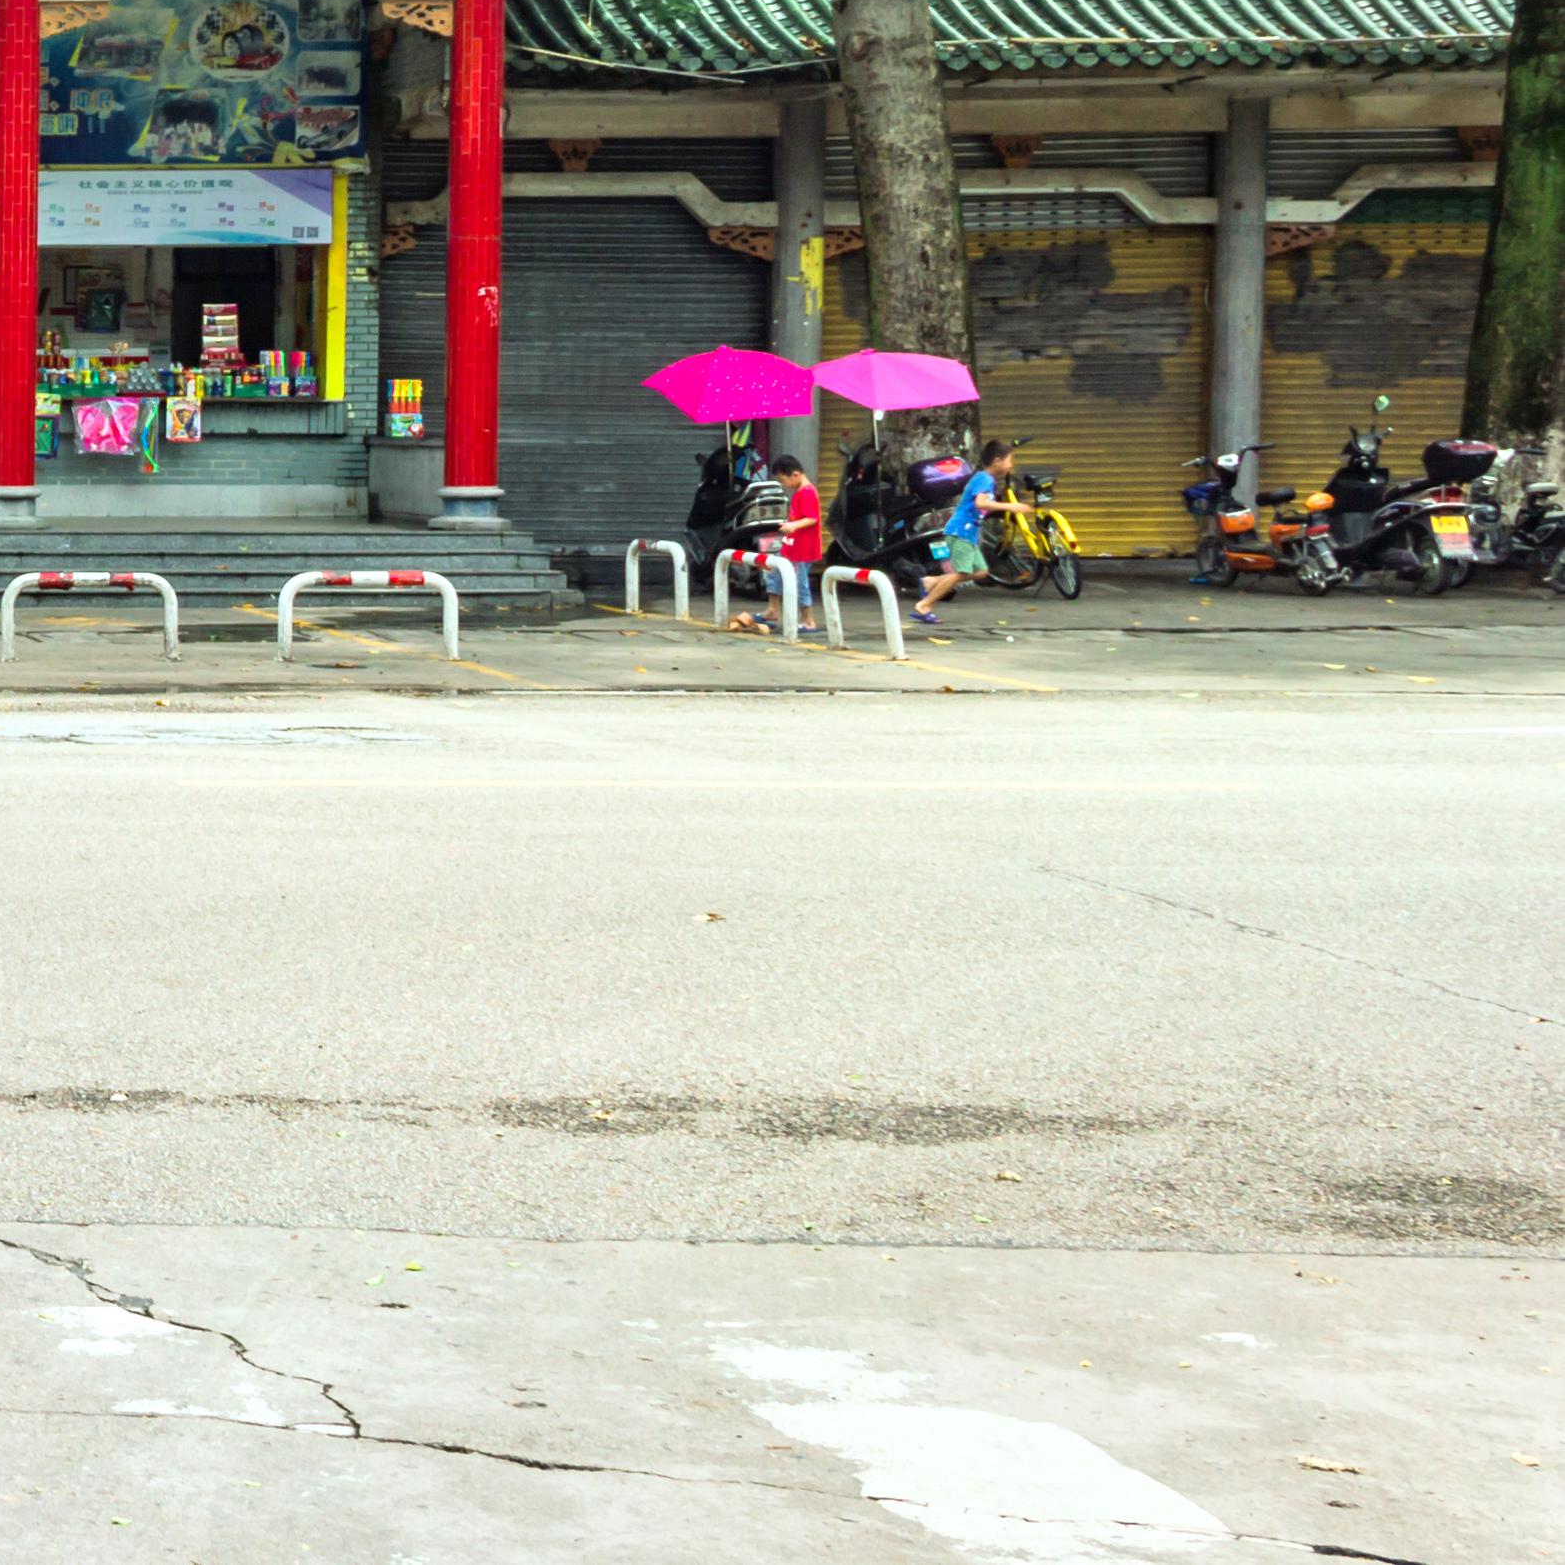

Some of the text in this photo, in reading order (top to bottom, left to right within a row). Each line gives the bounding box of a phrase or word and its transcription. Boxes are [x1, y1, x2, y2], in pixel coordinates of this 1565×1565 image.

[78, 179, 234, 189] 社会主义核心价值观
